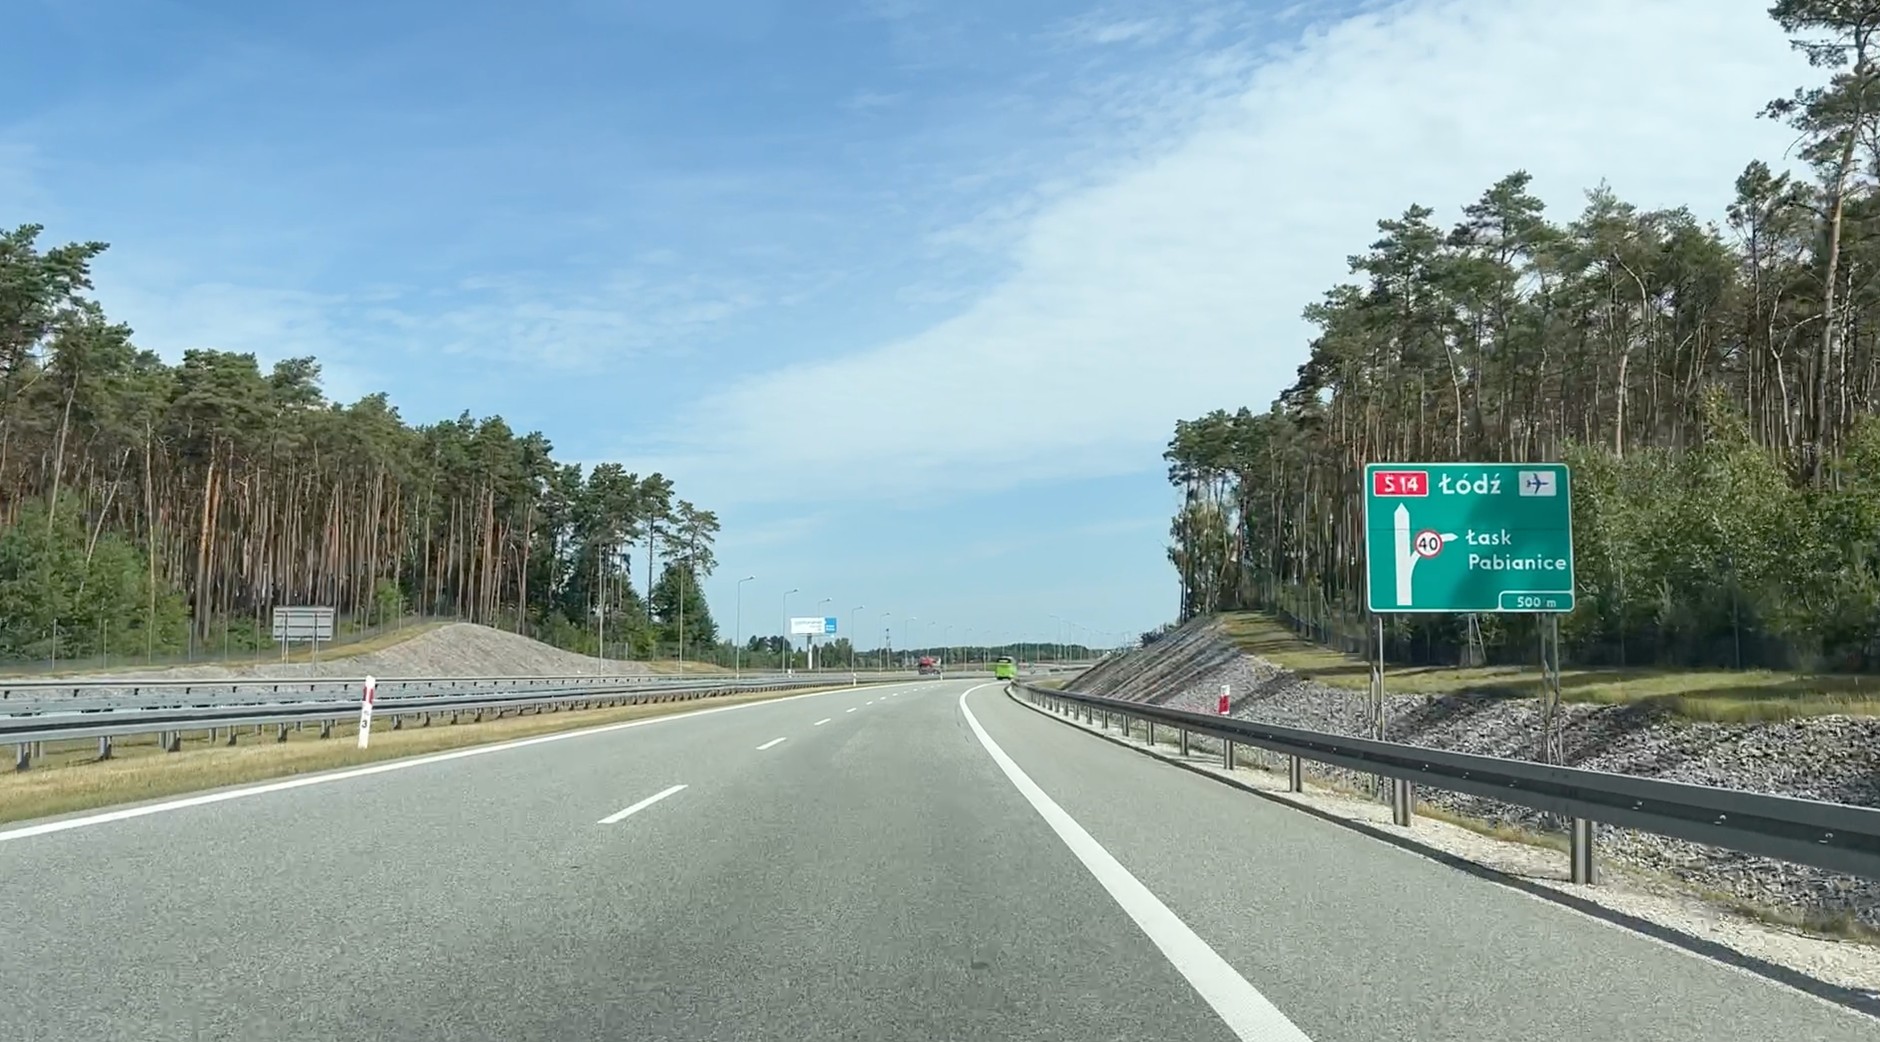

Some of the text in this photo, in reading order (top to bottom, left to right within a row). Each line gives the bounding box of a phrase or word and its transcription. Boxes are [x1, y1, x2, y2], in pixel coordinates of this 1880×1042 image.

[1438, 473, 1501, 495] Łódź
[1418, 537, 1438, 551] 40
[1466, 529, 1511, 545] Łask
[1469, 554, 1566, 571] Pabianice
[1517, 596, 1556, 608] 500 m
[362, 720, 368, 728] 3
